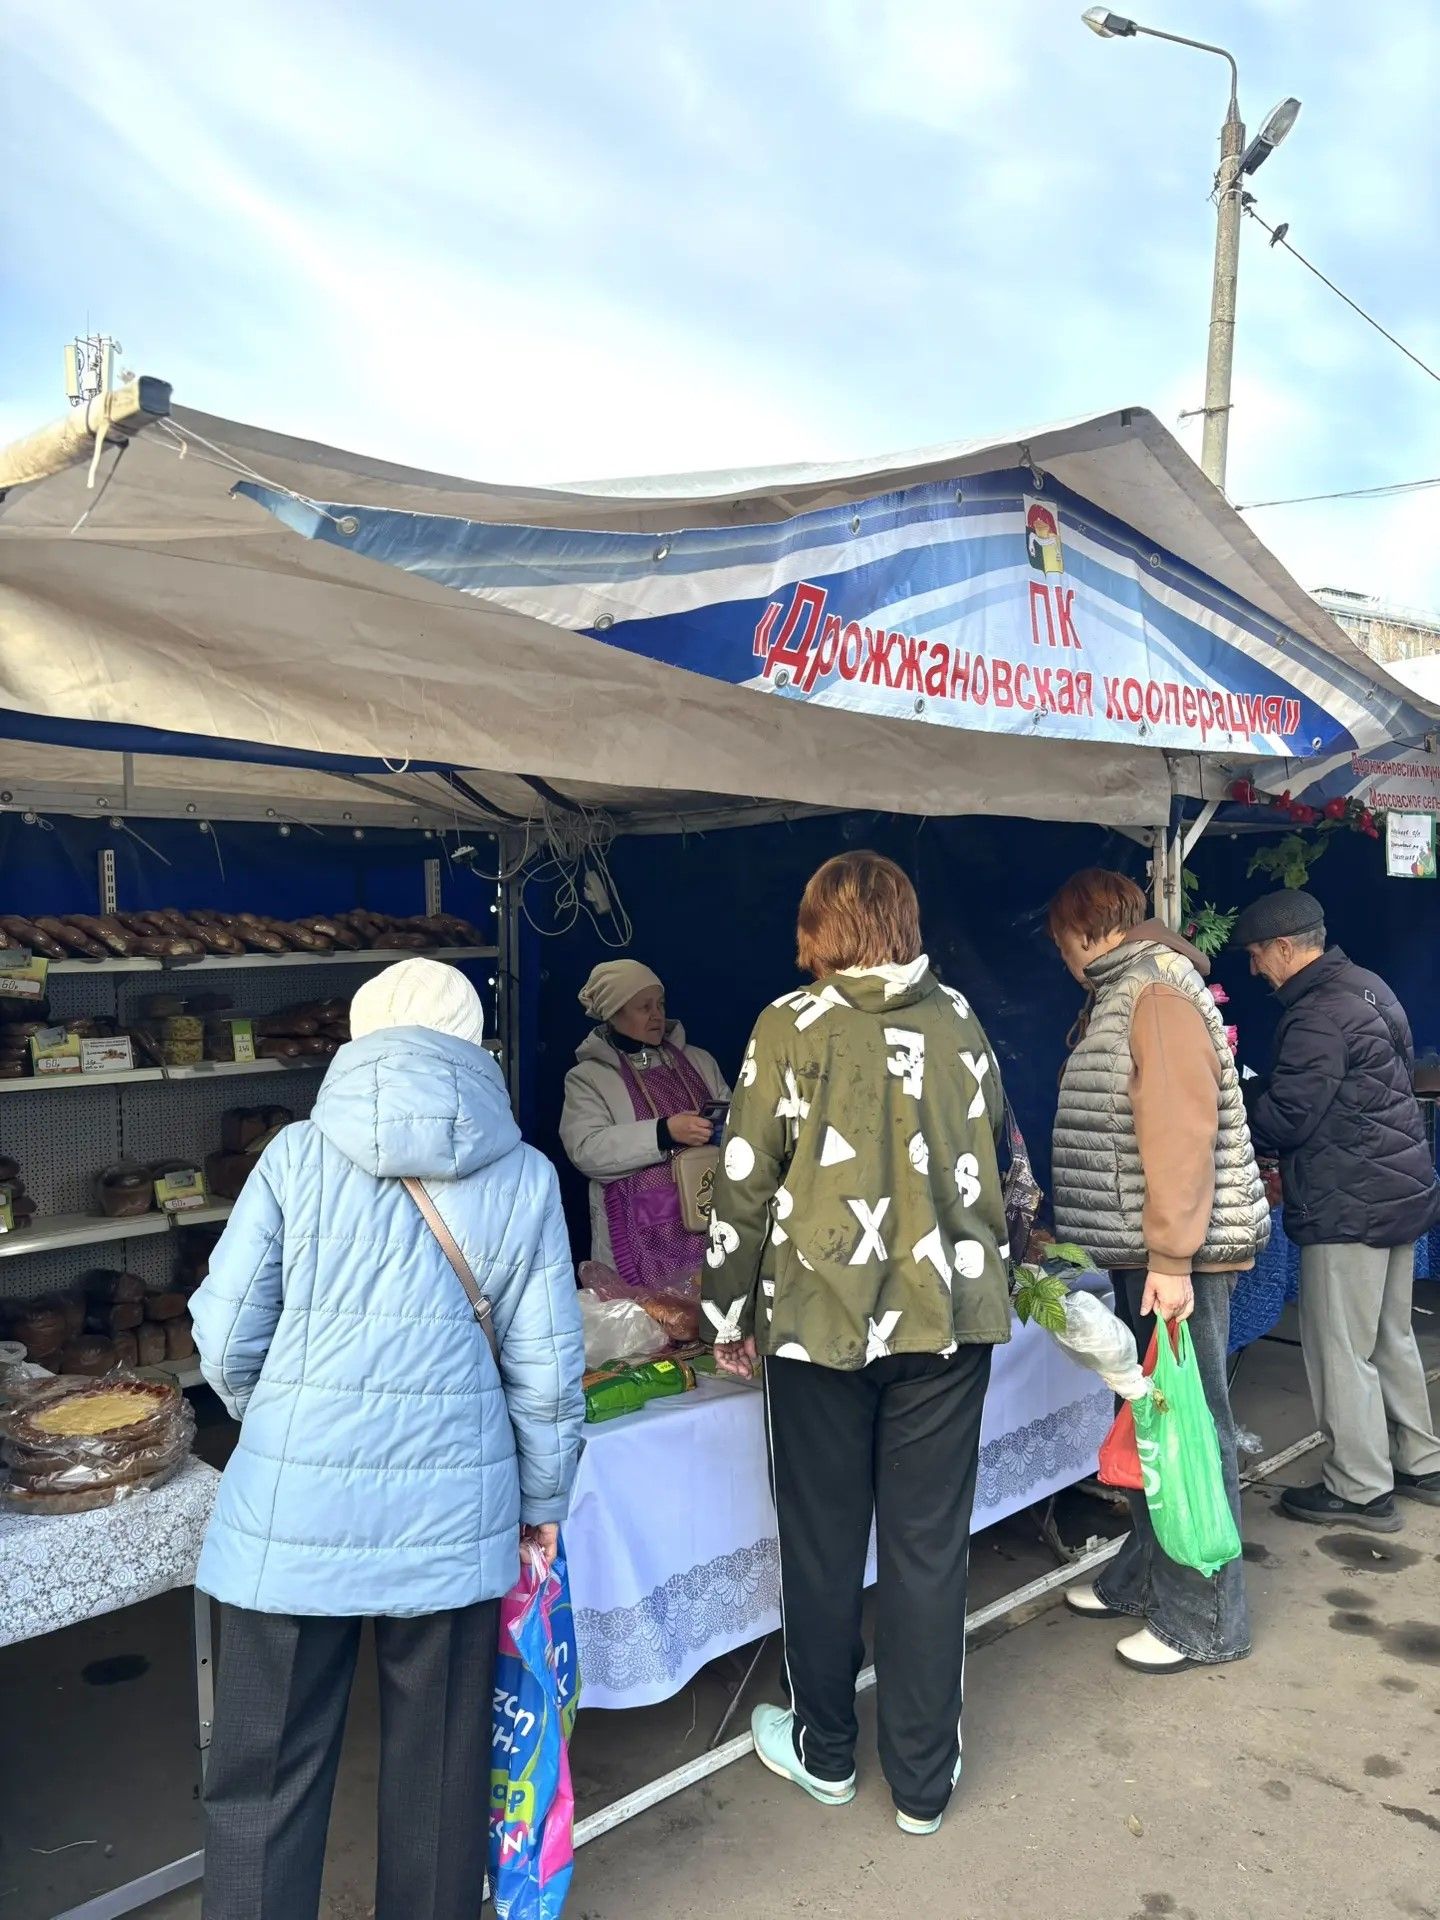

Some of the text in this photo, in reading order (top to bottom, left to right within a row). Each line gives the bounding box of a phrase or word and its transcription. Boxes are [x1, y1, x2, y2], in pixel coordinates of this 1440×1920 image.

[752, 581, 1300, 743] «Дрожжановская кооперация»
[1028, 580, 1083, 650] ПК
